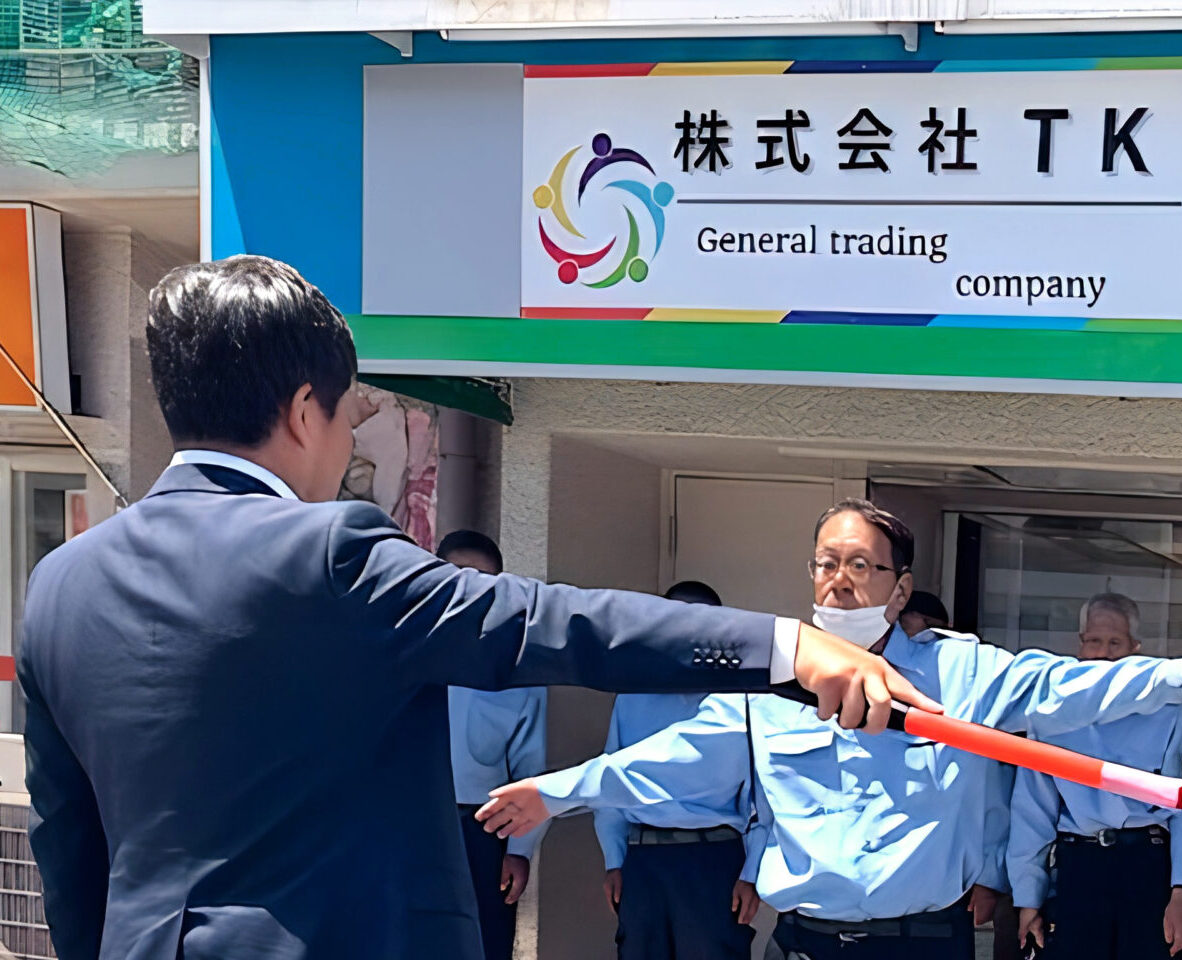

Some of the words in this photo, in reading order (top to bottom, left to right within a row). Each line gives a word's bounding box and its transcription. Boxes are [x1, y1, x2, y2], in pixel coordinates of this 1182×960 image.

[673, 107, 979, 175] 株式会社
[1022, 106, 1155, 177] TK
[697, 224, 818, 257] General
[830, 225, 950, 264] trading
[954, 272, 1107, 308] company
